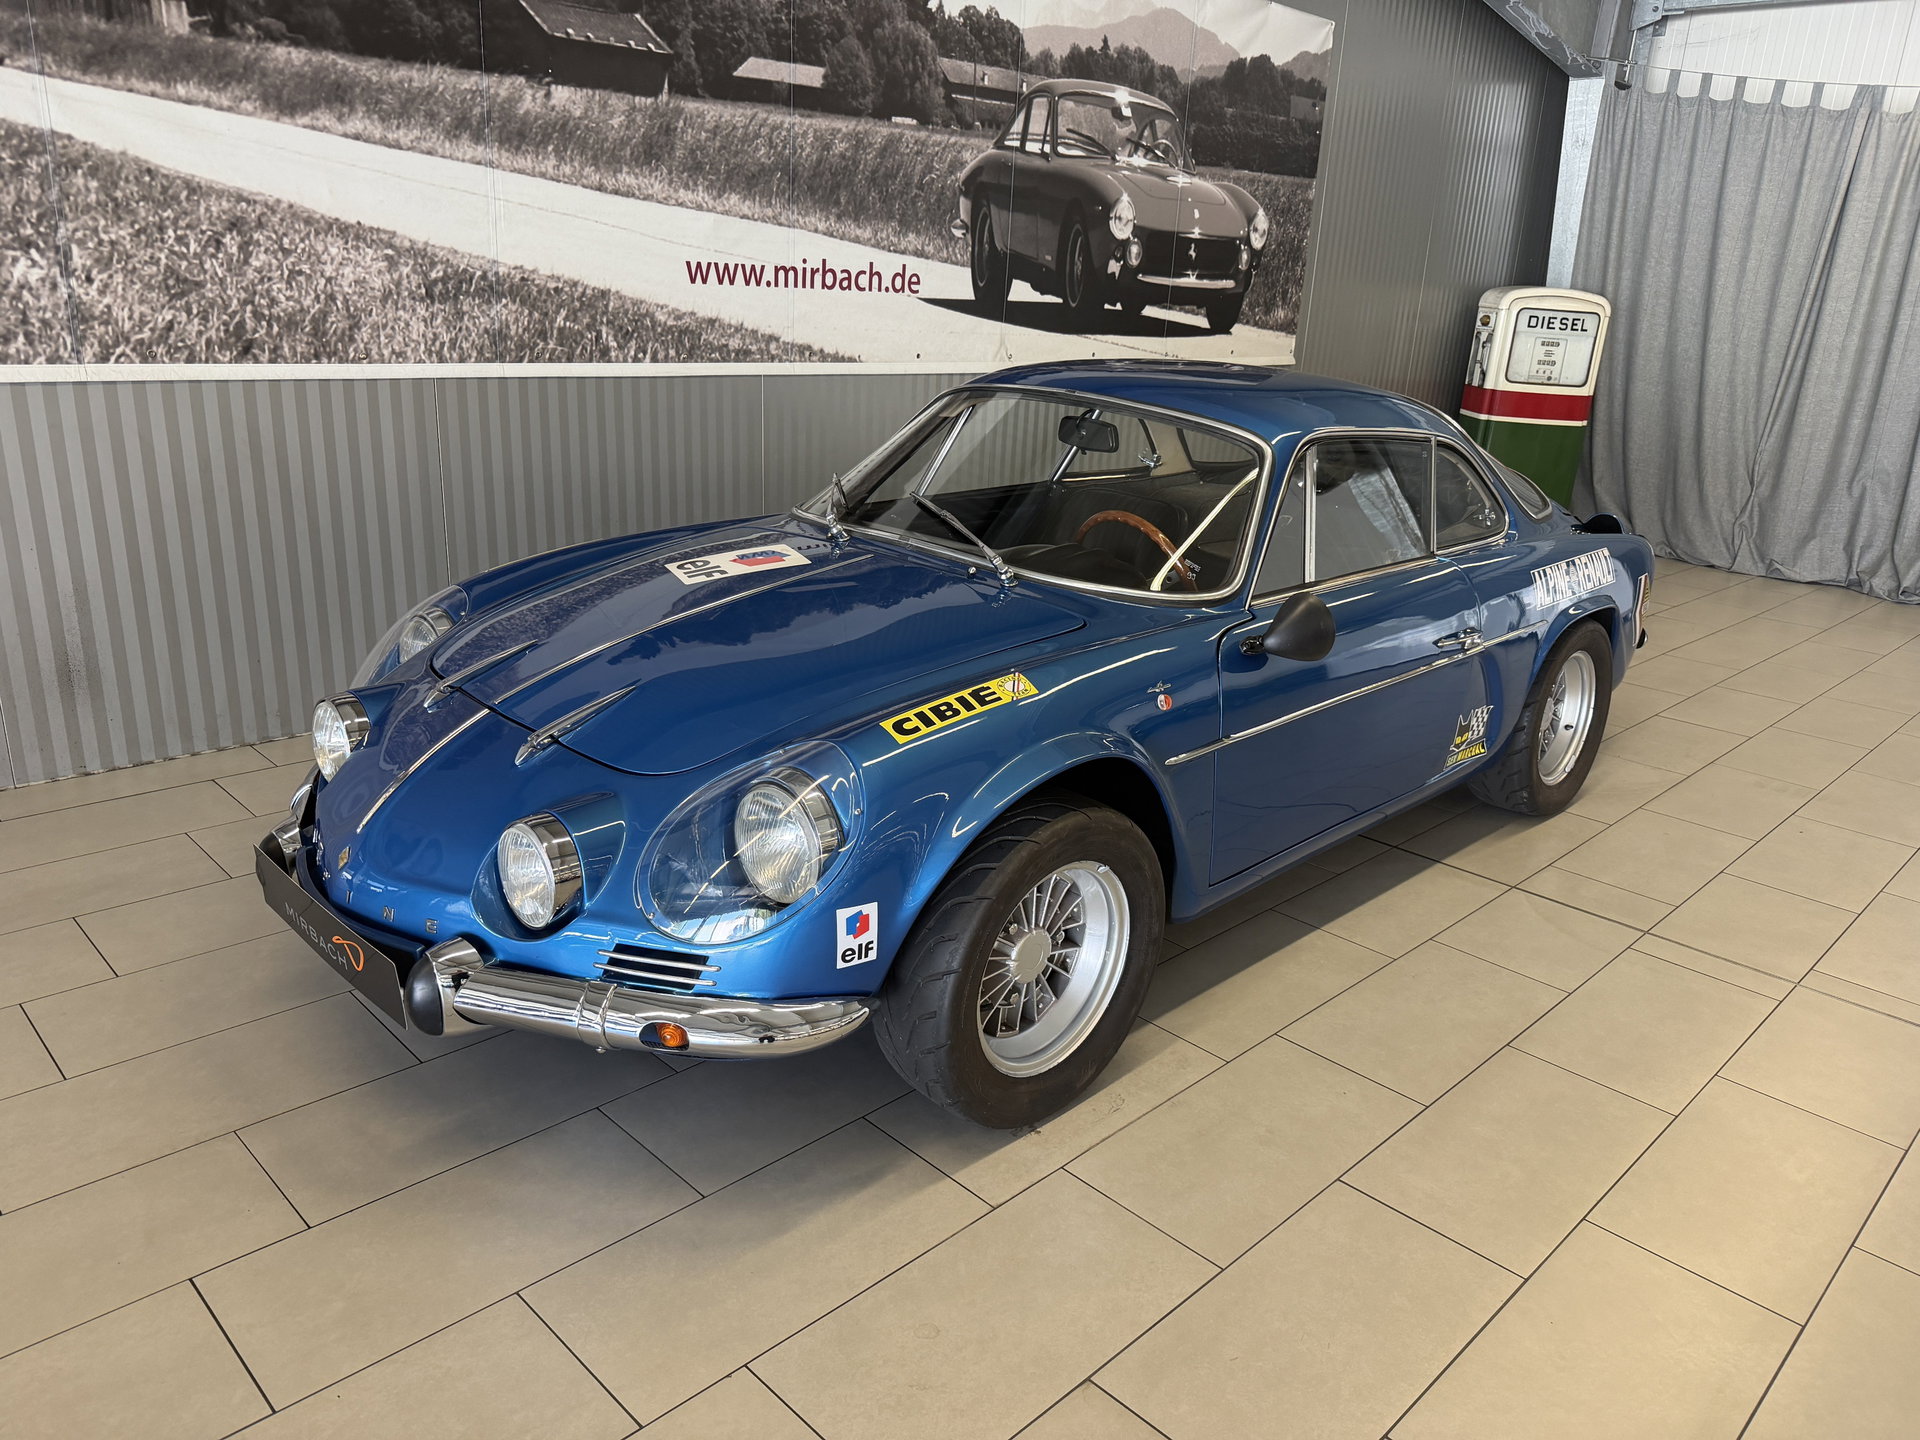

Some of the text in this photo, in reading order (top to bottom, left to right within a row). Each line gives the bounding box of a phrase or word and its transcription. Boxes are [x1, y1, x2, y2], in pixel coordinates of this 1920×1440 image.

[685, 258, 921, 294] www.mirbach.de
[1527, 315, 1588, 332] DIESEL
[676, 559, 729, 579] elf
[1534, 550, 1614, 608] ALPINE RENAULT
[285, 902, 348, 970] MIRBACH
[841, 940, 874, 964] elf
